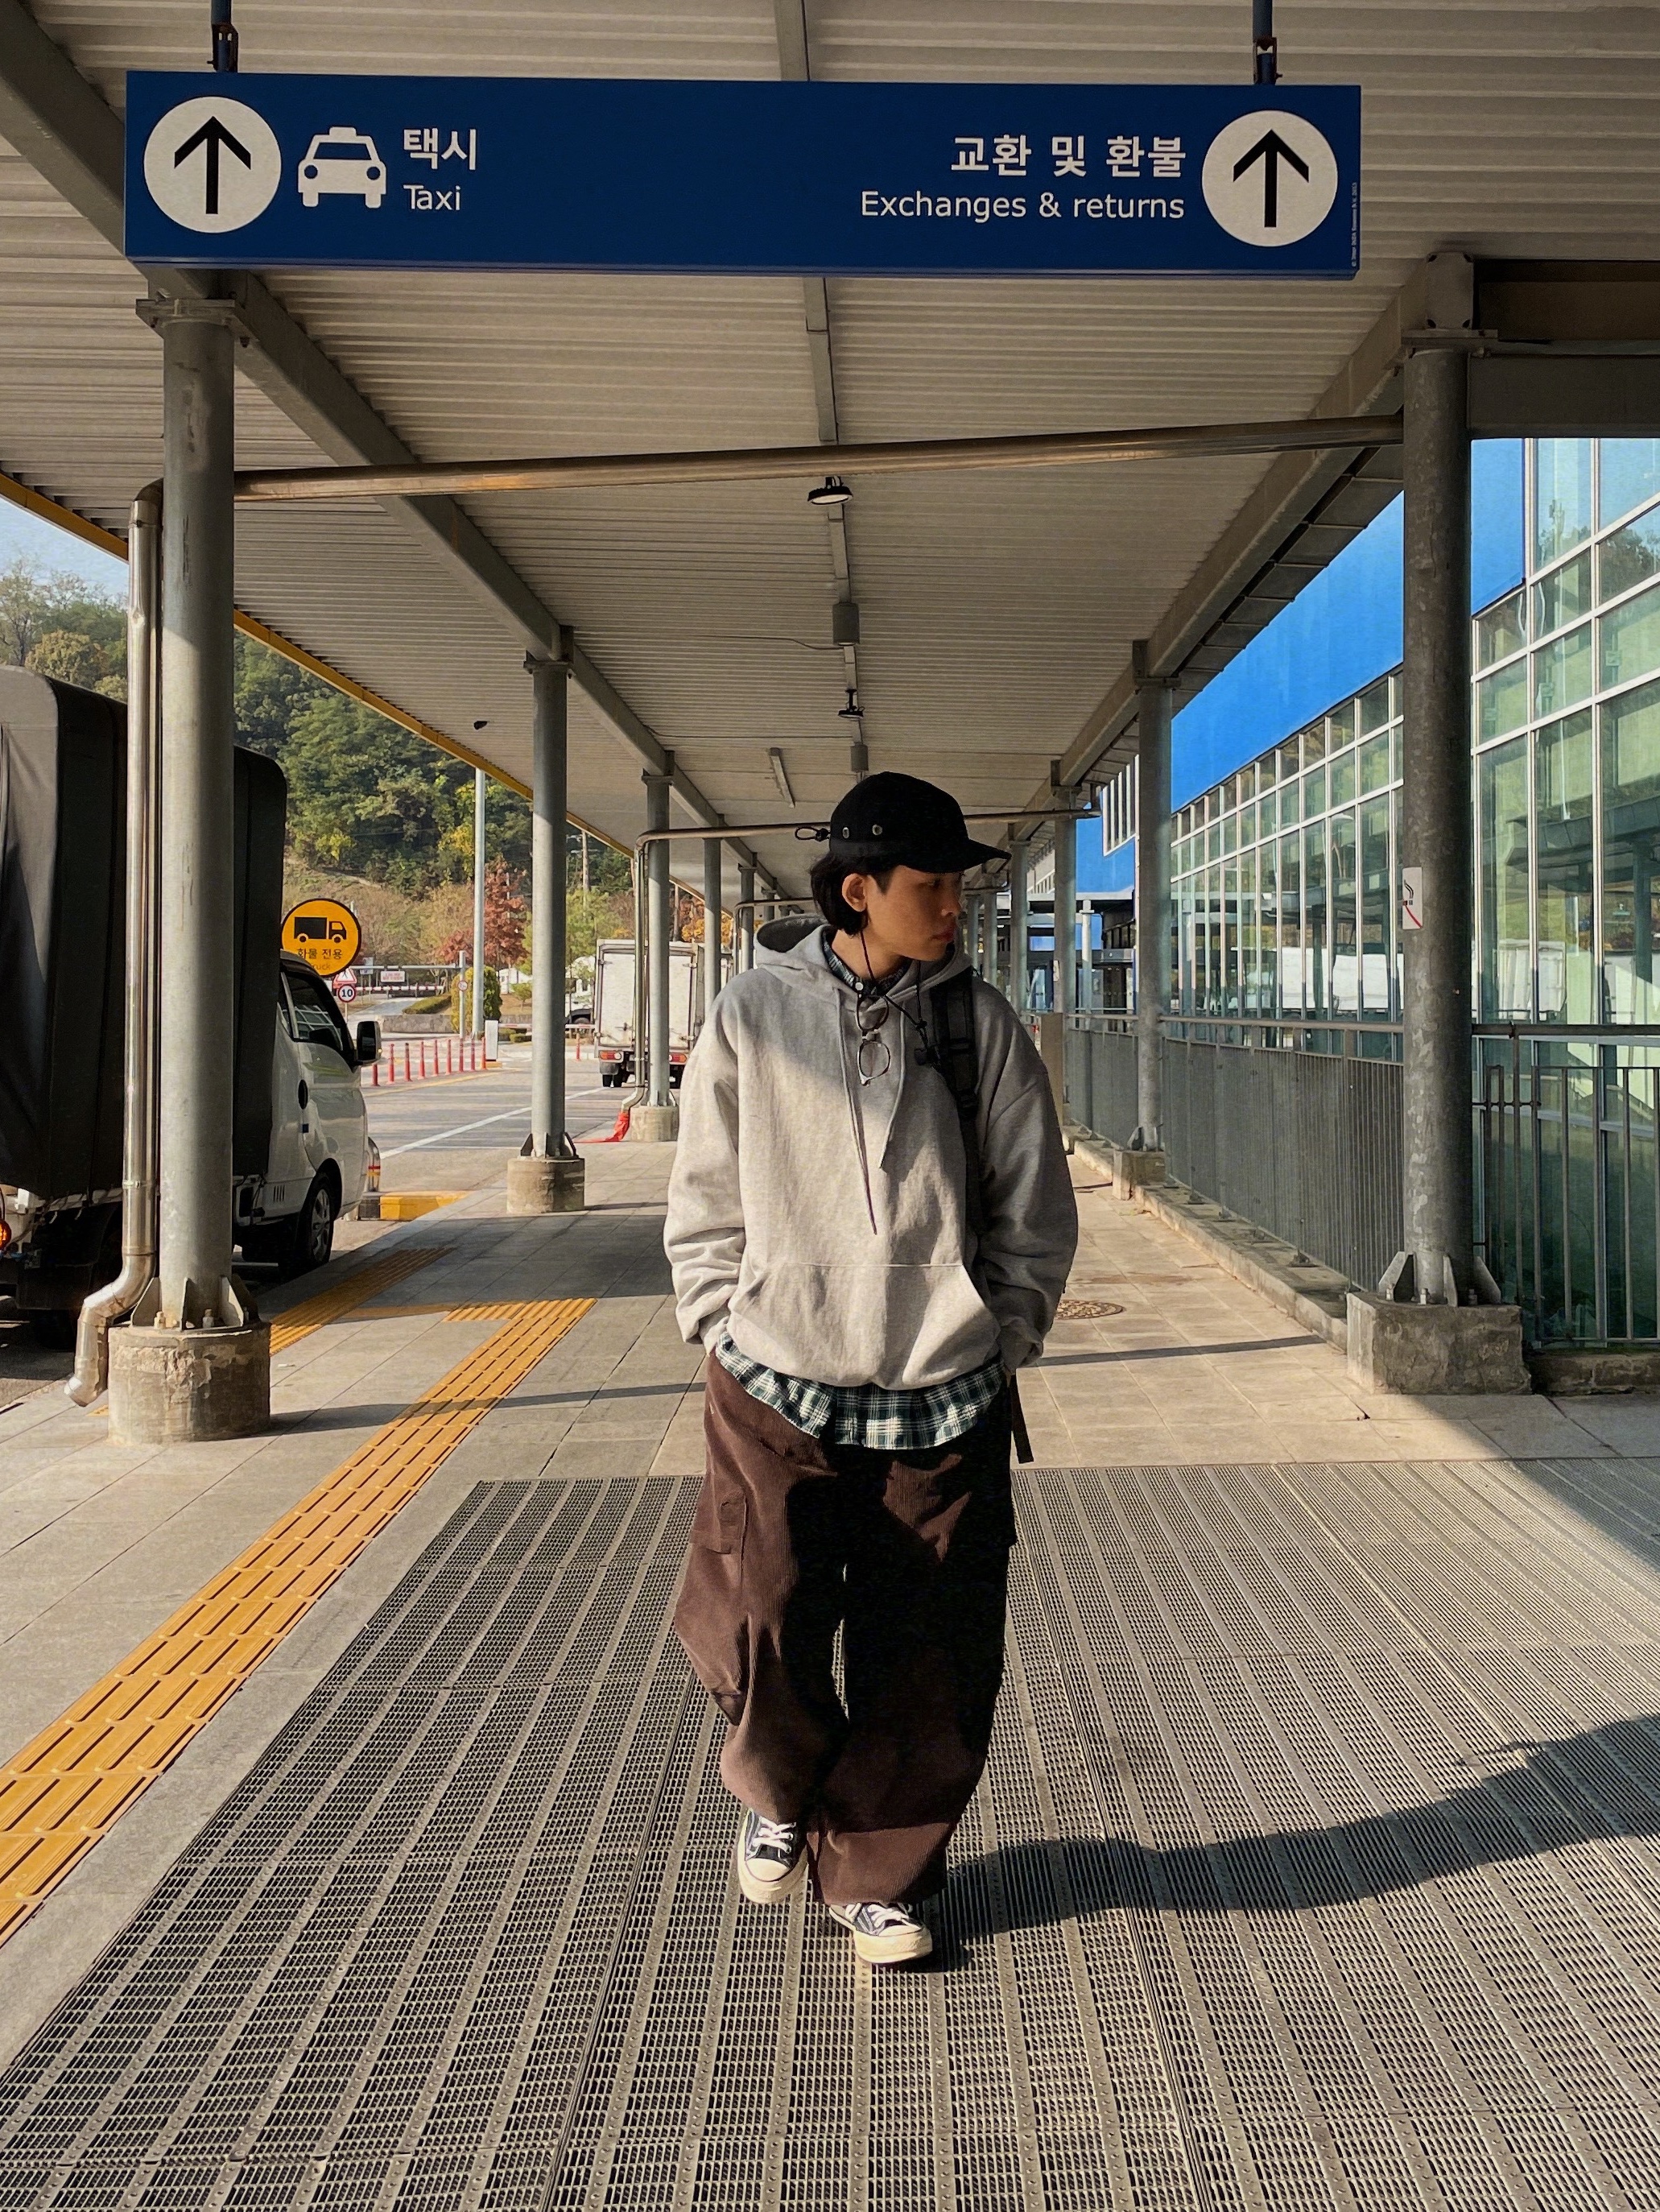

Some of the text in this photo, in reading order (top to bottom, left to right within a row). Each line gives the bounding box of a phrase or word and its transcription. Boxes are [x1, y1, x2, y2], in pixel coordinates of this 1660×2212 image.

[404, 128, 477, 171] 택시
[952, 134, 1187, 178] 교환 및 환불
[403, 184, 461, 211] Taxi
[861, 191, 1184, 223] Exchanges & returns
[297, 948, 342, 960] 화물 전용
[341, 989, 353, 998] 10
